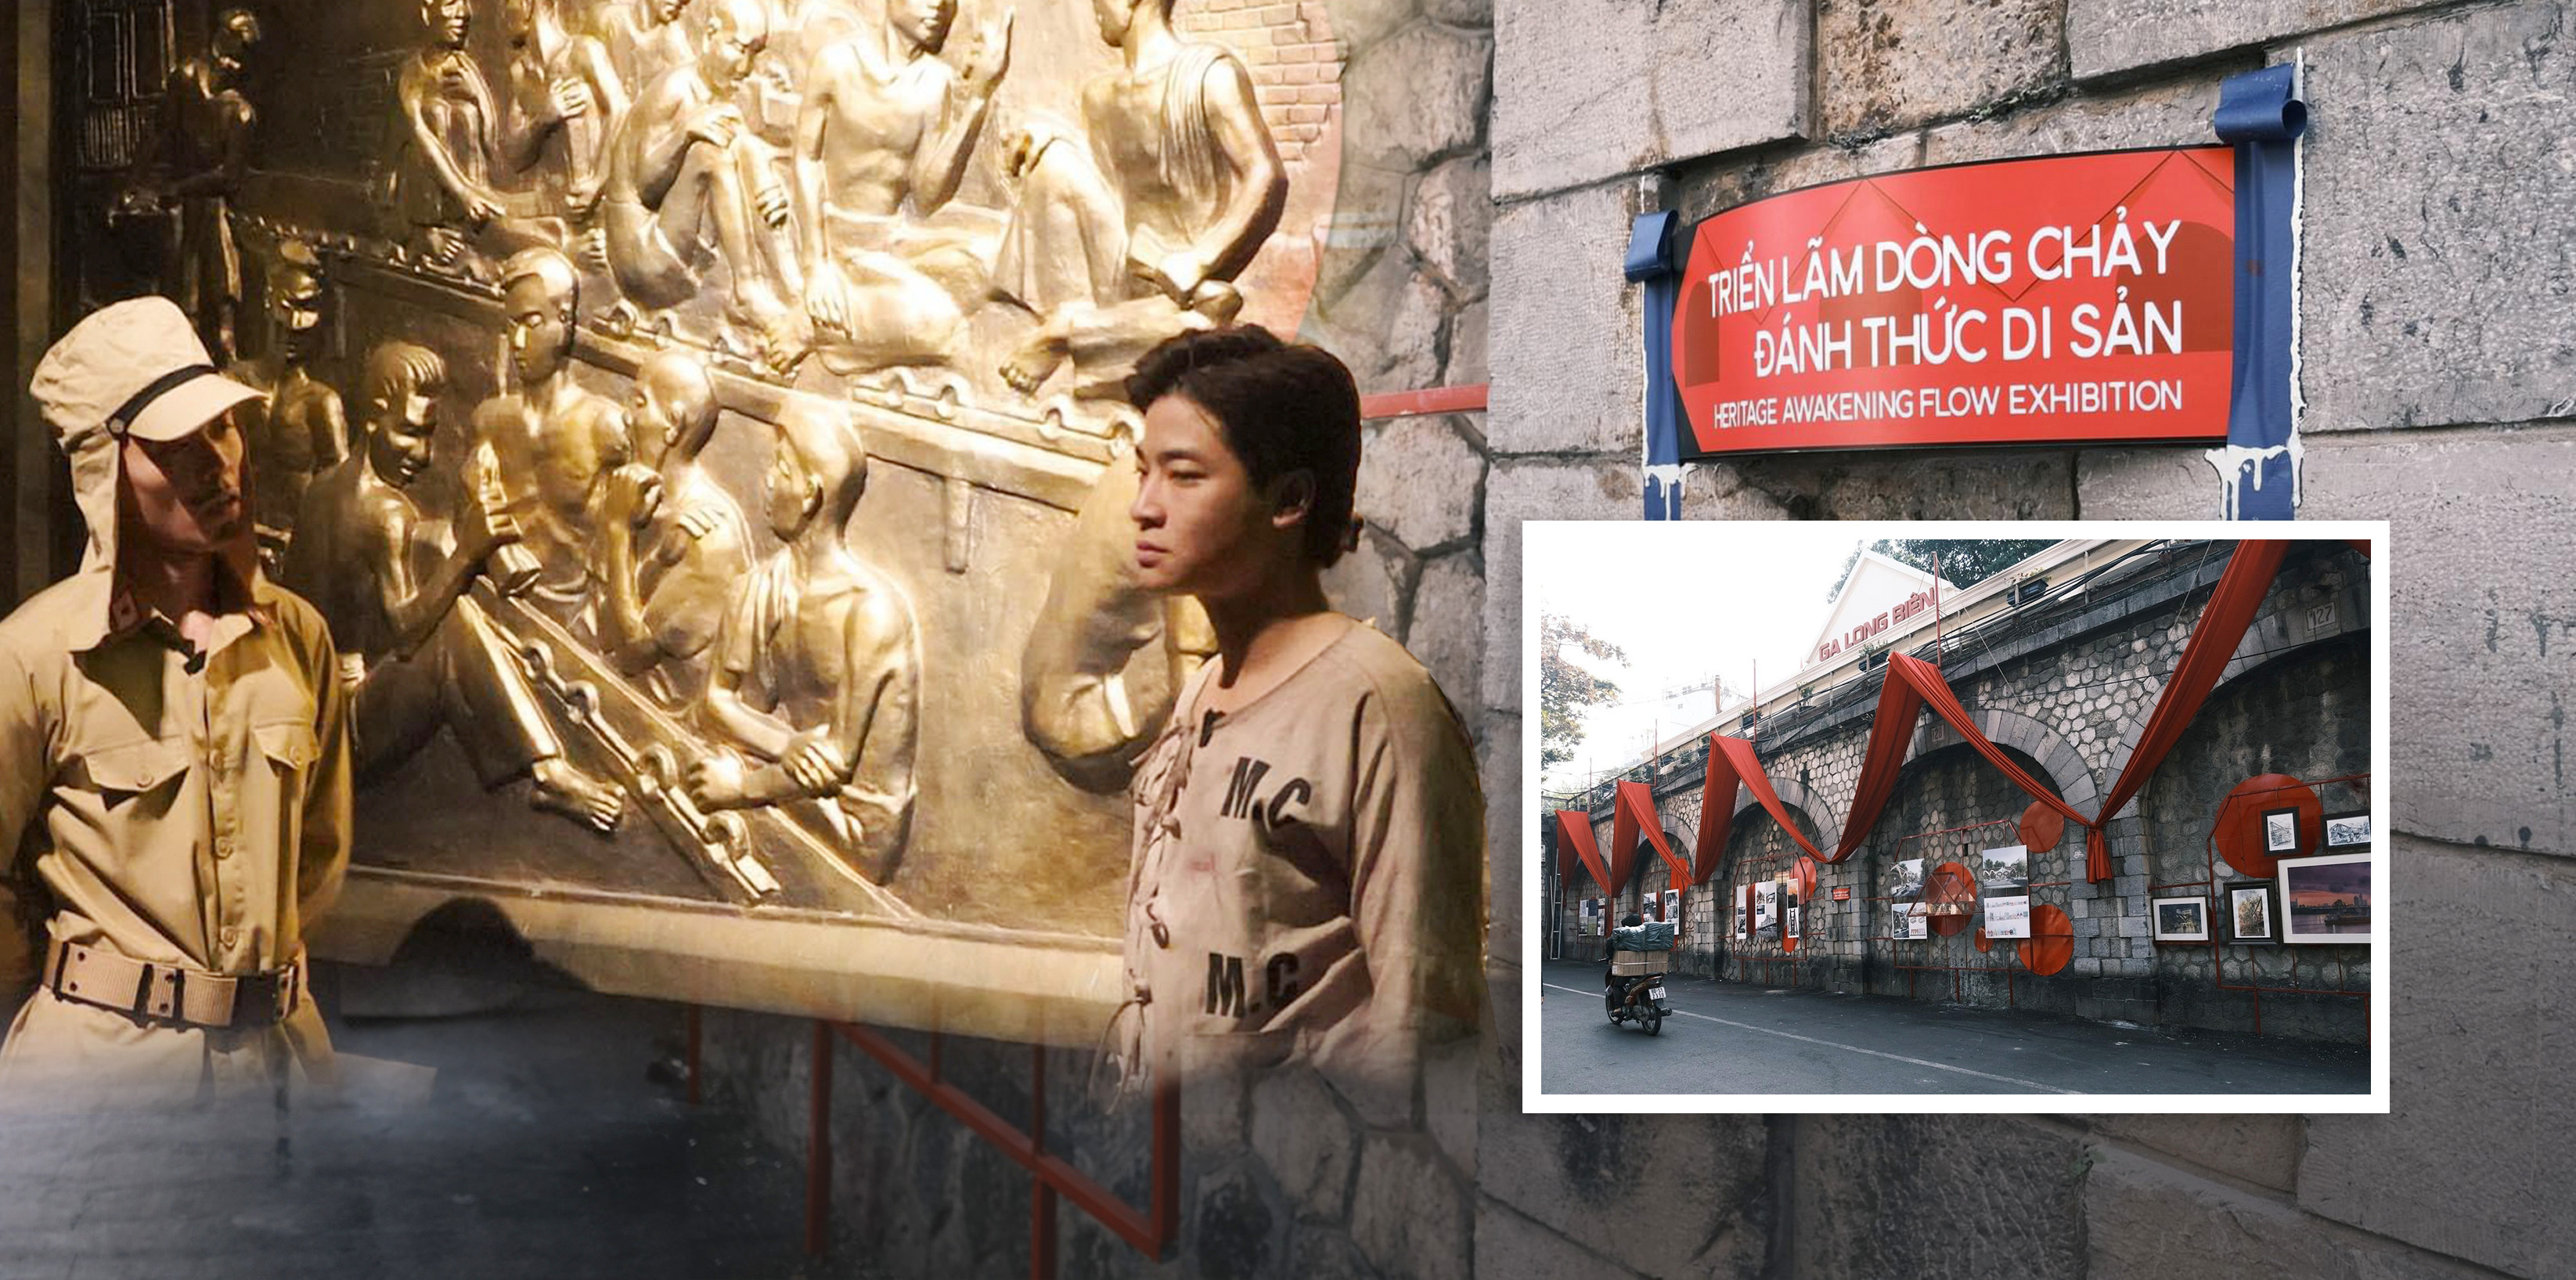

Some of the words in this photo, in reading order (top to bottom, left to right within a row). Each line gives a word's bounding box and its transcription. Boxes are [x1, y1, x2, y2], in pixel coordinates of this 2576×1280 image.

[1708, 240, 1775, 318] TRIỂN
[1781, 236, 1864, 305] LÃM
[1875, 221, 2012, 293] DÒNG
[2026, 205, 2181, 281] CHẢY
[1753, 310, 1852, 378] ĐÁNH
[1861, 295, 1987, 369] THỨC
[2002, 305, 2052, 361] DI
[2070, 285, 2182, 359] SẢN
[1714, 395, 1778, 429] HERITAGE
[1782, 388, 1914, 424] AWAKENING
[1919, 385, 2001, 418] FLOW
[2009, 380, 2182, 415] EXHIBITION
[1818, 638, 1842, 662] GA
[1844, 611, 1889, 650] LONG
[1892, 587, 1936, 626] BIÊN
[2311, 605, 2333, 626] 127
